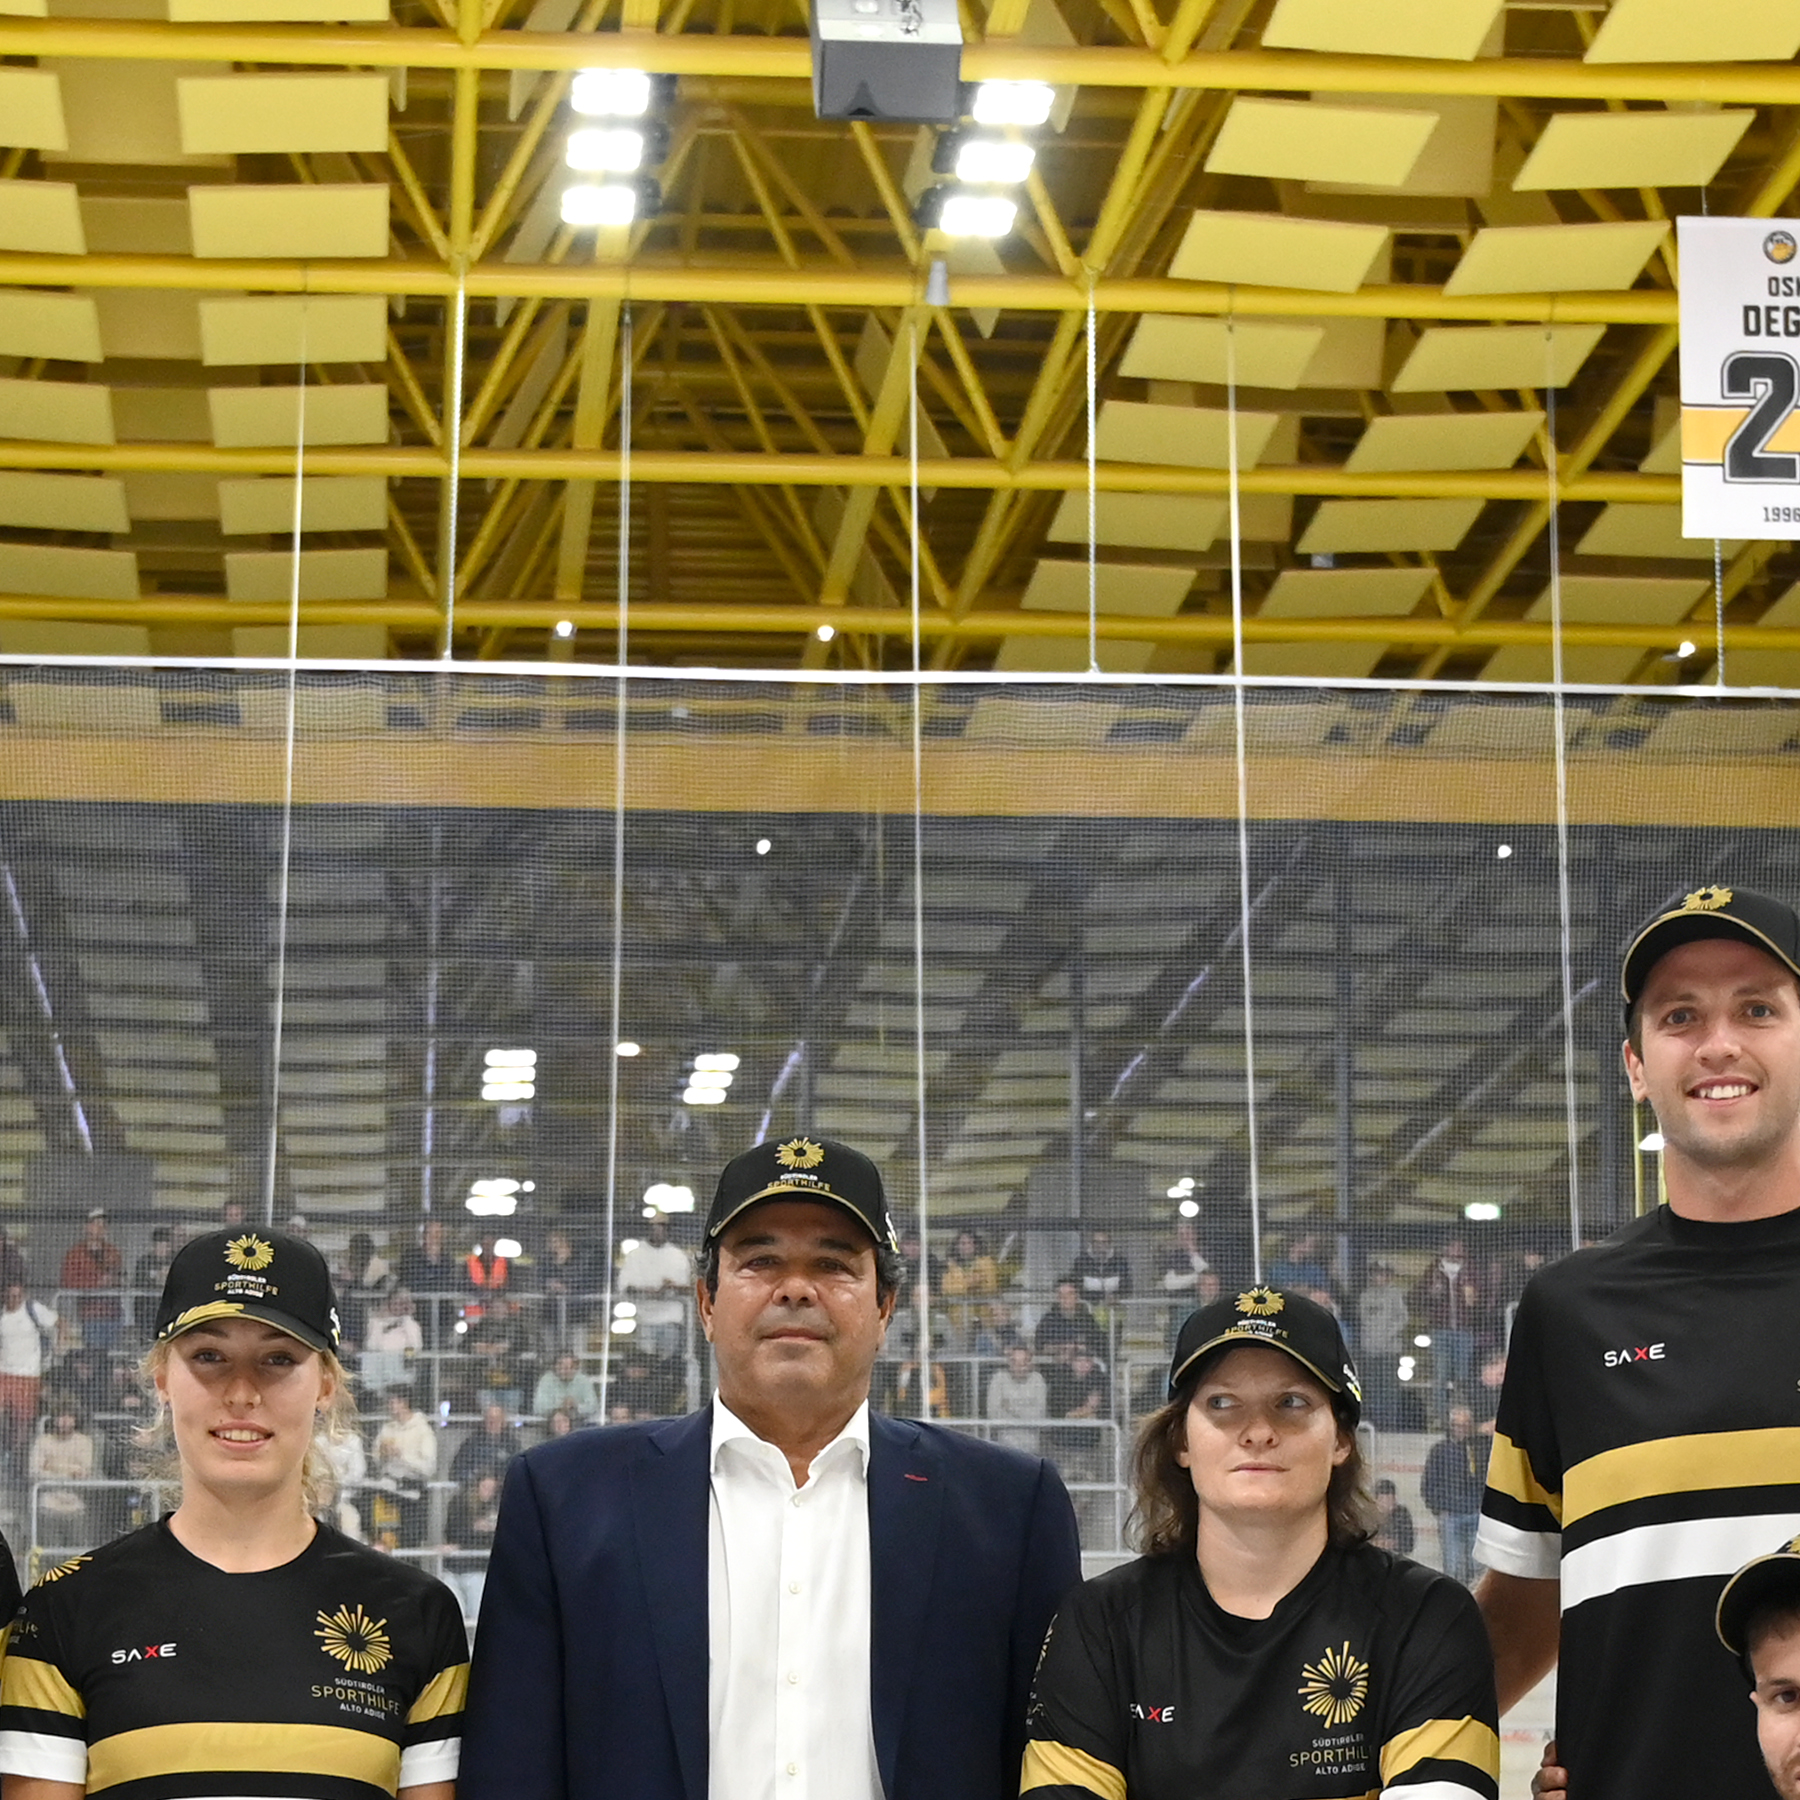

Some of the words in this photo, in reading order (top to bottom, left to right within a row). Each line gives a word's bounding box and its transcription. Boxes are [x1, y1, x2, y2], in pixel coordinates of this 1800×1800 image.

[214, 1280, 280, 1296] SPORTHILFE
[1603, 1342, 1666, 1368] SAXE
[111, 1642, 177, 1665] SAXE
[310, 1684, 400, 1716] SPORTHILFE
[339, 1702, 362, 1714] ALTO
[1289, 1744, 1372, 1768] SPORTHIL
[1315, 1764, 1339, 1776] ALTO
